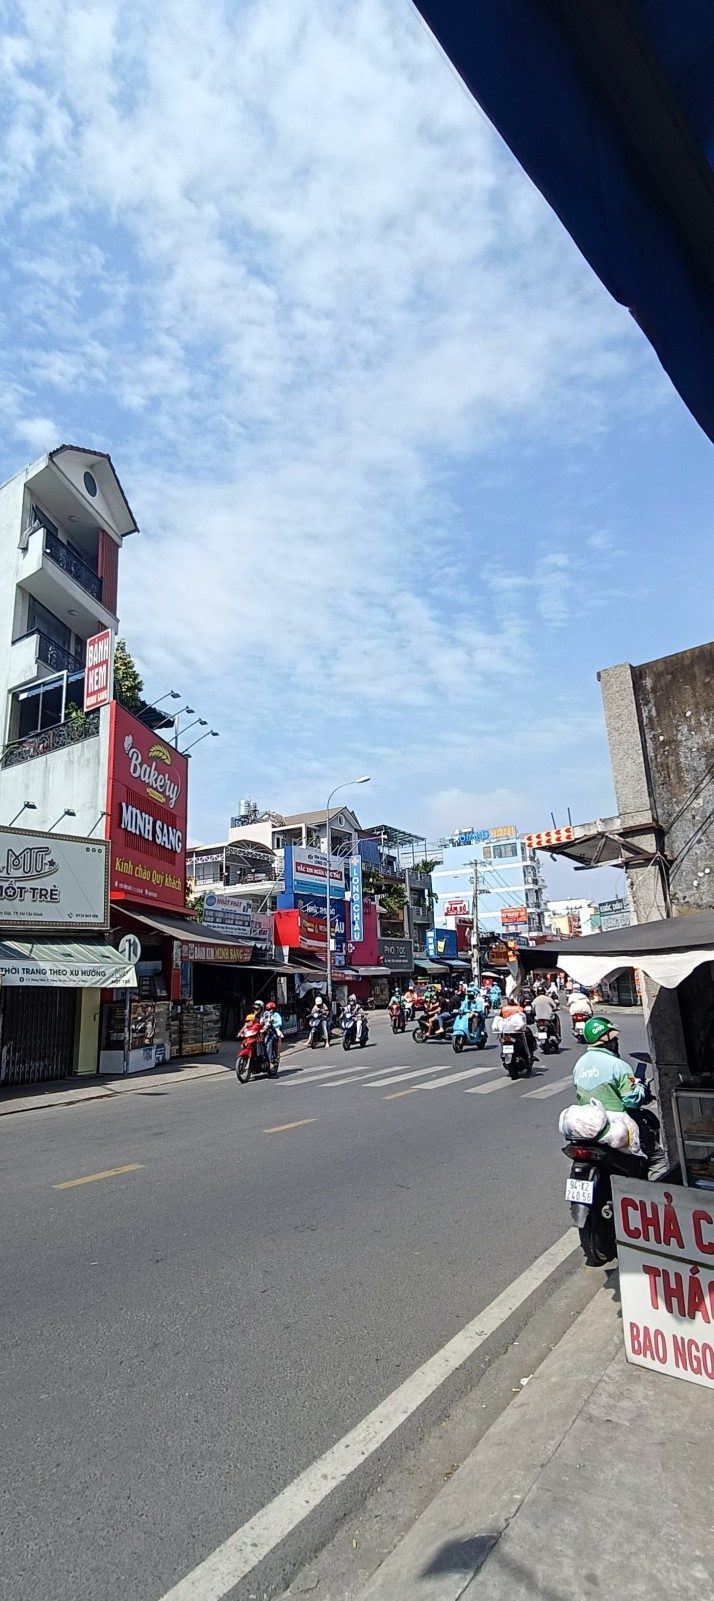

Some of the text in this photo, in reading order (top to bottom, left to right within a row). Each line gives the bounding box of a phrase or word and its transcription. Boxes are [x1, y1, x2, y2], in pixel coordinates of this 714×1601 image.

[88, 637, 109, 667] BÁNH
[88, 664, 107, 693] KEM
[128, 748, 178, 808] Bakery
[121, 801, 183, 854] MINH SANG
[115, 857, 182, 891] Kính chào Quý khách
[352, 868, 360, 900] LONG
[30, 884, 59, 901] TRẺ
[215, 947, 229, 960] MINH
[229, 947, 244, 960] SANG
[0, 966, 20, 975] THỜI
[22, 967, 47, 975] TRANG
[49, 968, 68, 976] THEO
[69, 969, 80, 977] XU
[81, 967, 107, 978] HƯỚNG
[591, 1024, 605, 1035] Grab
[579, 1066, 600, 1078] Grab
[620, 1191, 685, 1250] CHẢ
[629, 1321, 668, 1365] BAO
